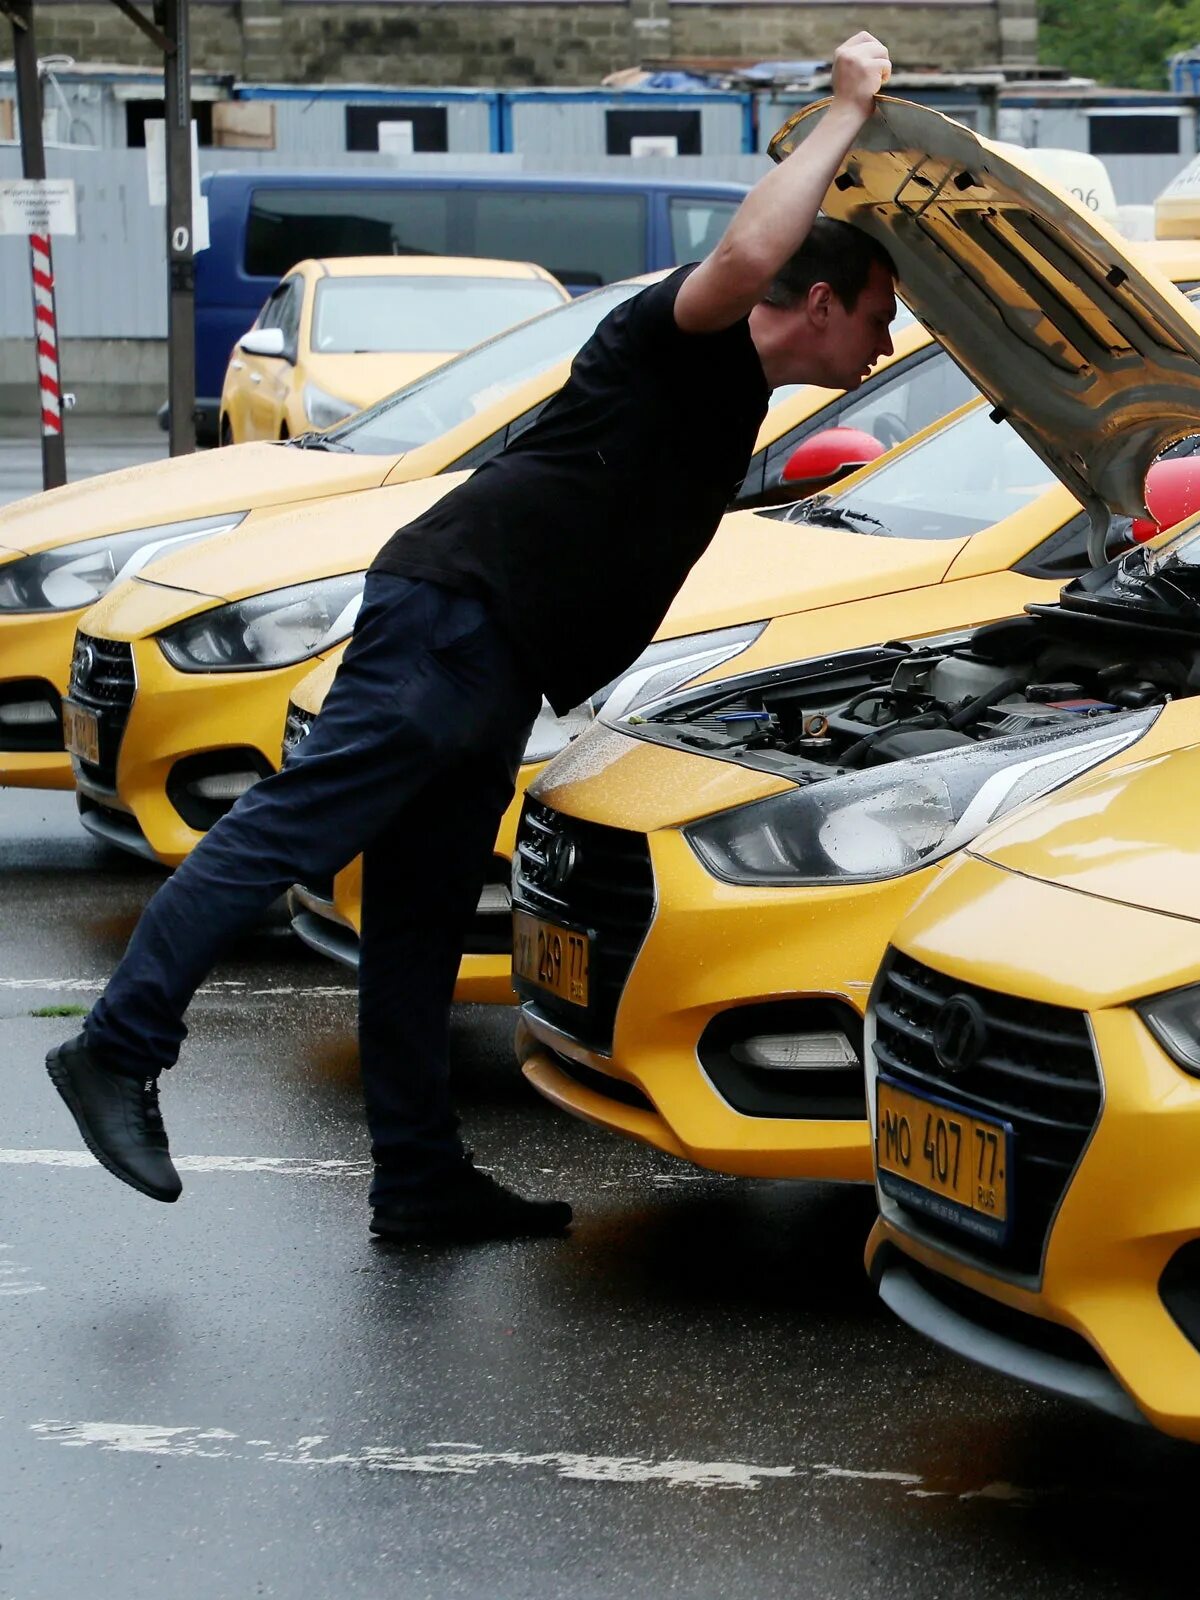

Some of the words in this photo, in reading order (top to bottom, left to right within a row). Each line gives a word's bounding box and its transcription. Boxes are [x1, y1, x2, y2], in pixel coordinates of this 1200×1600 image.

[537, 927, 563, 988] 269
[568, 936, 584, 981] 77
[923, 1112, 962, 1191] 407
[975, 1128, 998, 1186] 77
[977, 1185, 996, 1209] RUS
